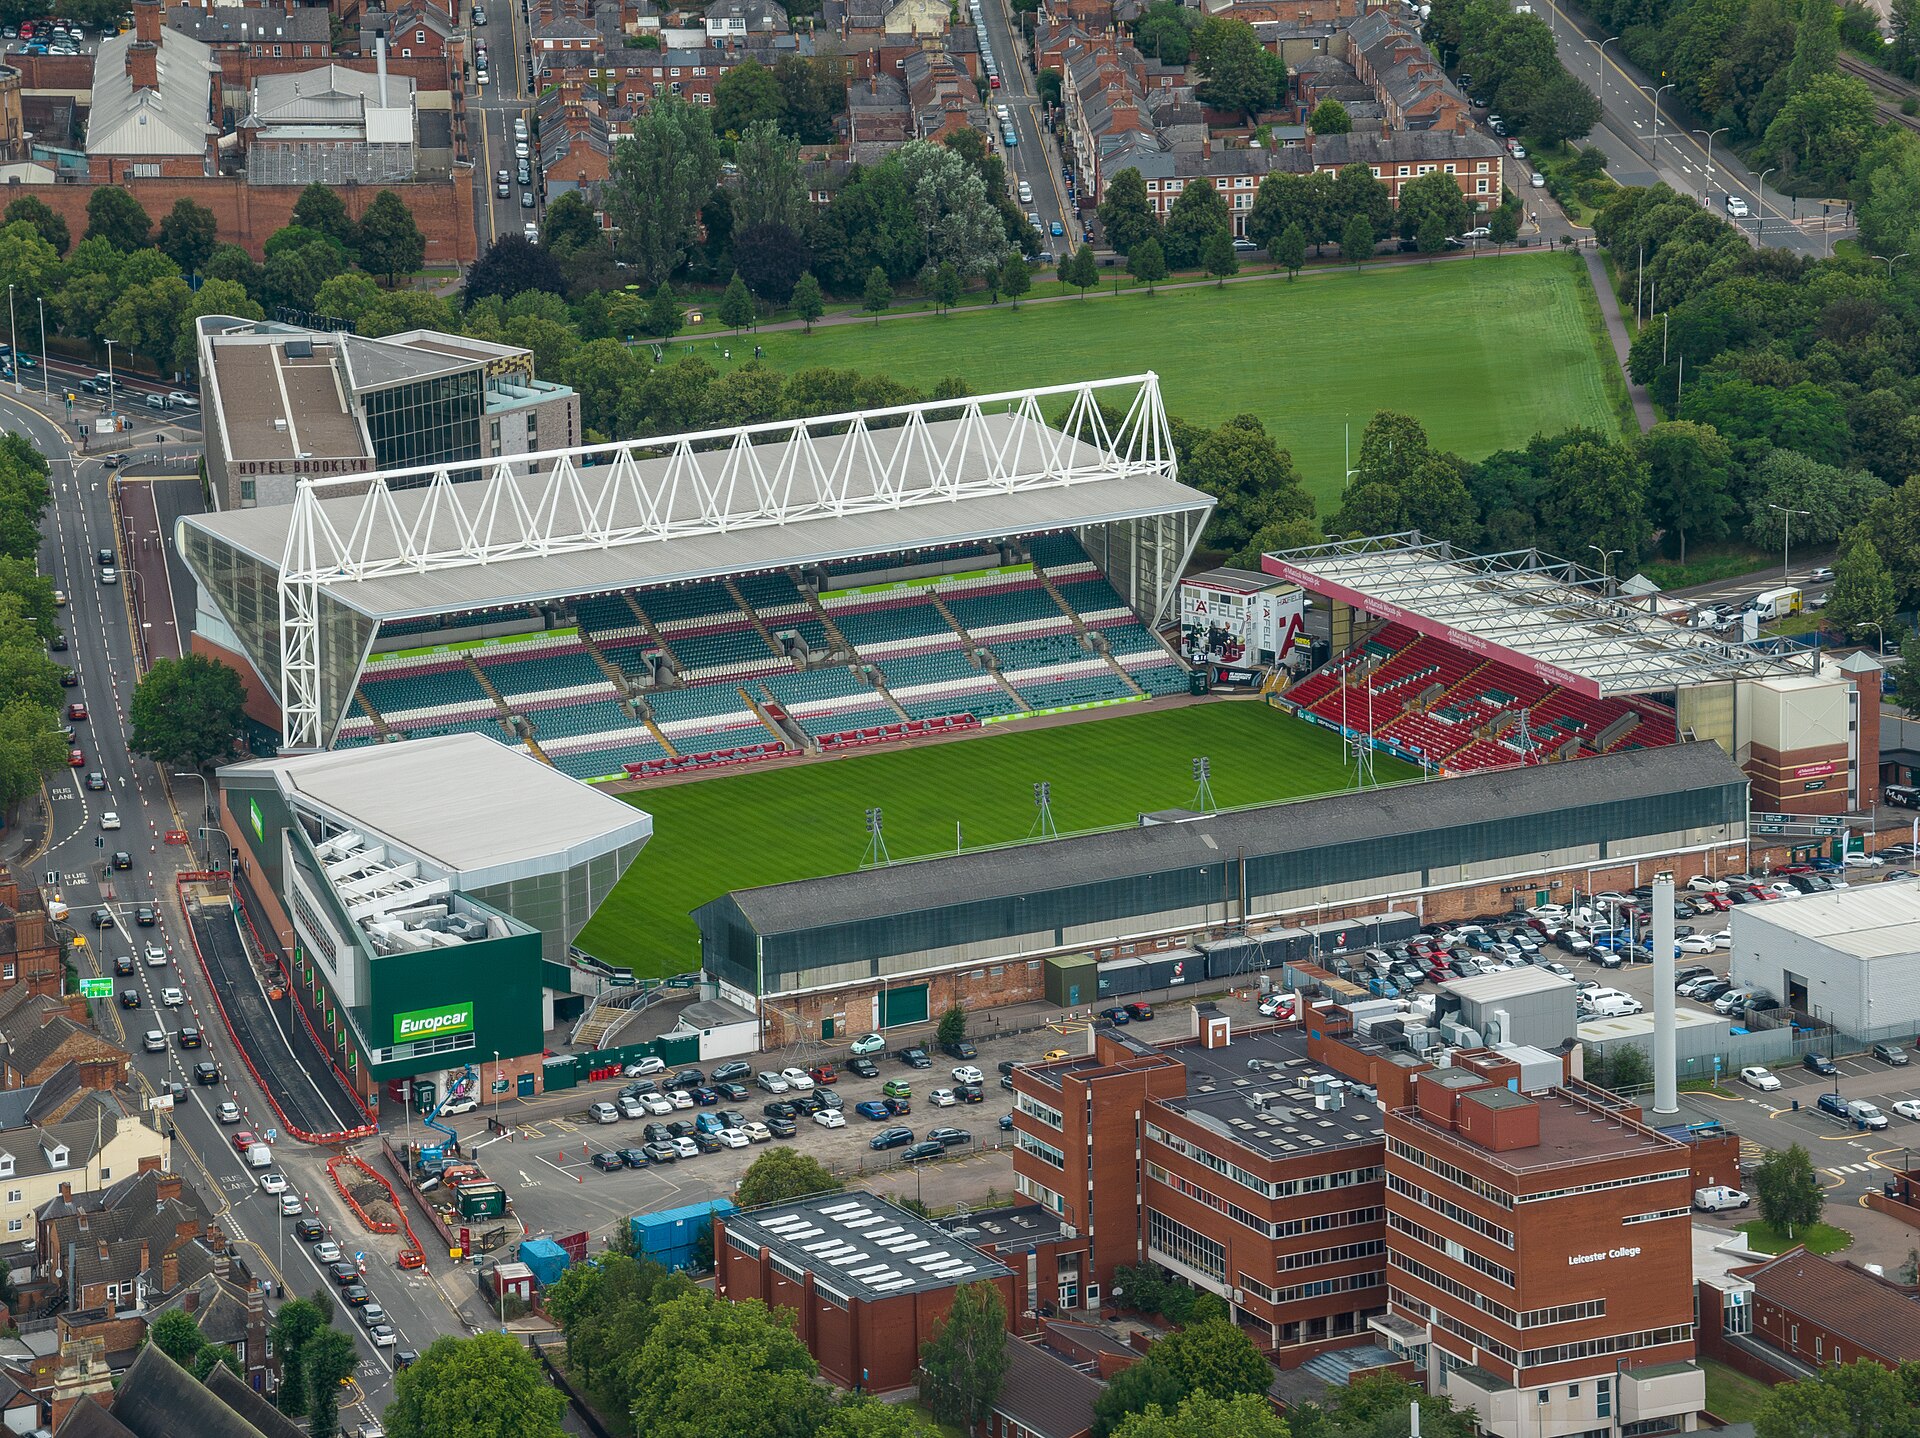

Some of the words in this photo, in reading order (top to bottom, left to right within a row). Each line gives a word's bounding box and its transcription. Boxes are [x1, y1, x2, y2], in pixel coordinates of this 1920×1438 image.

[239, 461, 285, 474] HOTEL
[293, 459, 367, 473] BROOKLYN
[1184, 597, 1245, 619] HÄFELE
[1263, 598, 1271, 649] HÄFELE
[66, 878, 90, 886] LANE
[401, 1012, 468, 1033] Europcar
[220, 1174, 242, 1183] BUS
[222, 1182, 251, 1191] LANE
[1568, 1252, 1607, 1265] Leicester
[1609, 1247, 1641, 1258] College
